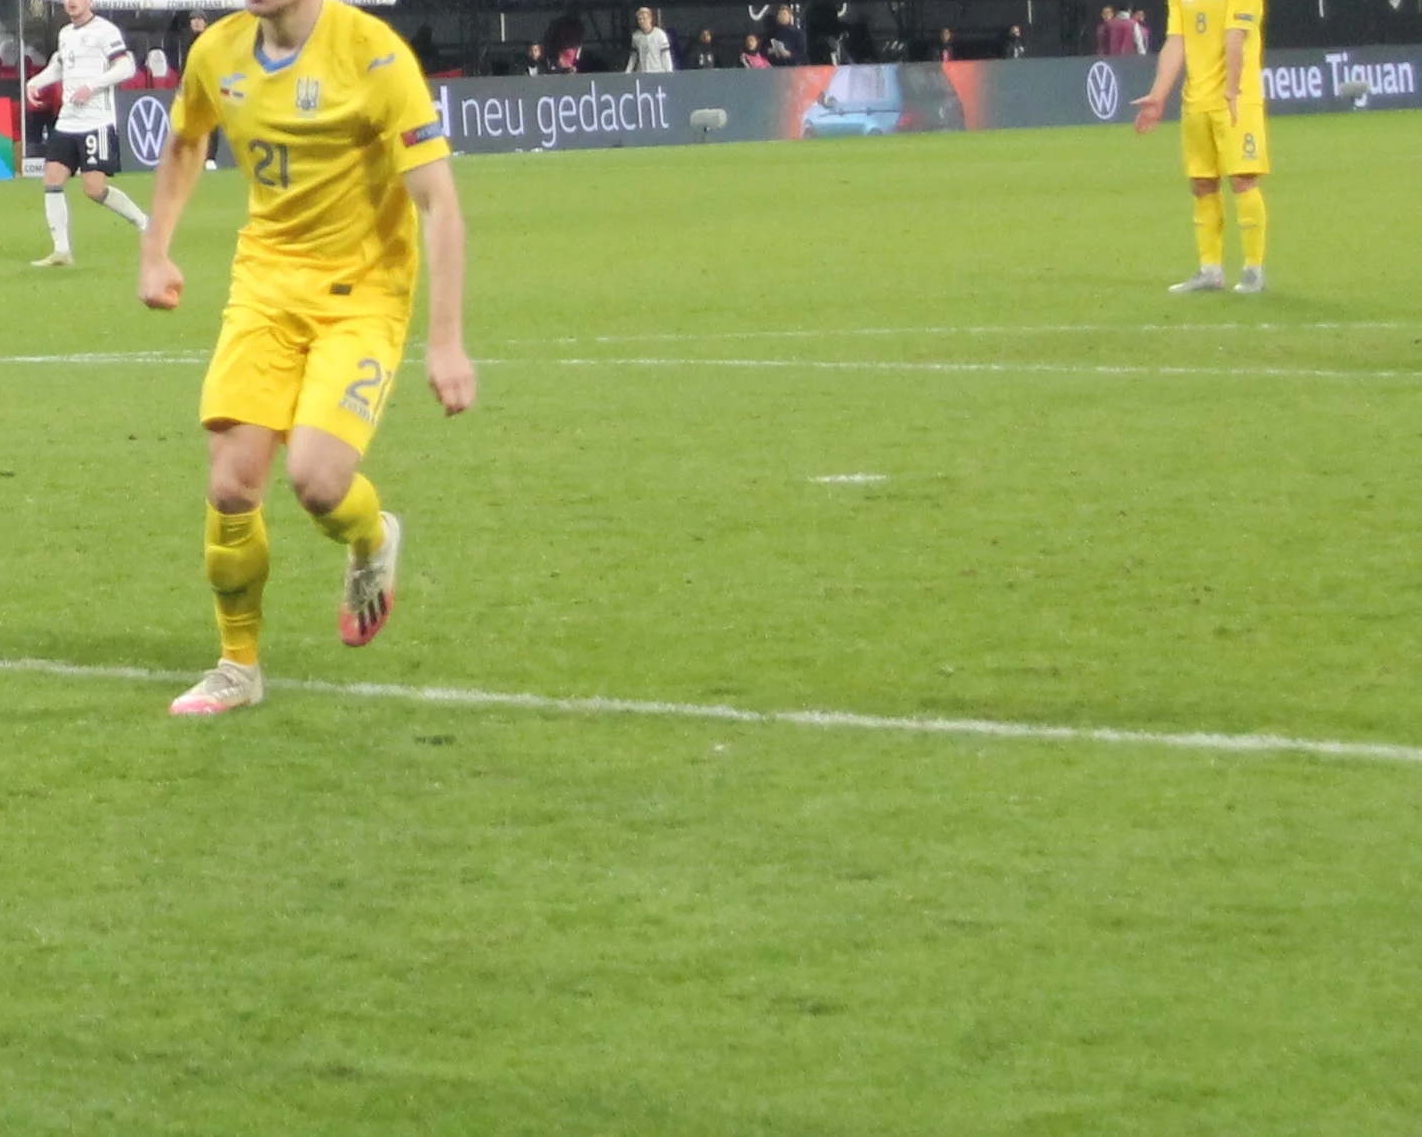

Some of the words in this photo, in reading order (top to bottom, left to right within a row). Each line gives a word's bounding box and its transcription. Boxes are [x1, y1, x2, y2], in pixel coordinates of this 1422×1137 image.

[1196, 12, 1207, 33] 8
[1261, 65, 1322, 100] neue
[1325, 52, 1415, 107] Tiguan
[461, 97, 525, 137] neu
[536, 79, 669, 148] gedacht
[85, 135, 98, 154] 9
[1243, 132, 1255, 154] 8
[249, 138, 290, 189] 21
